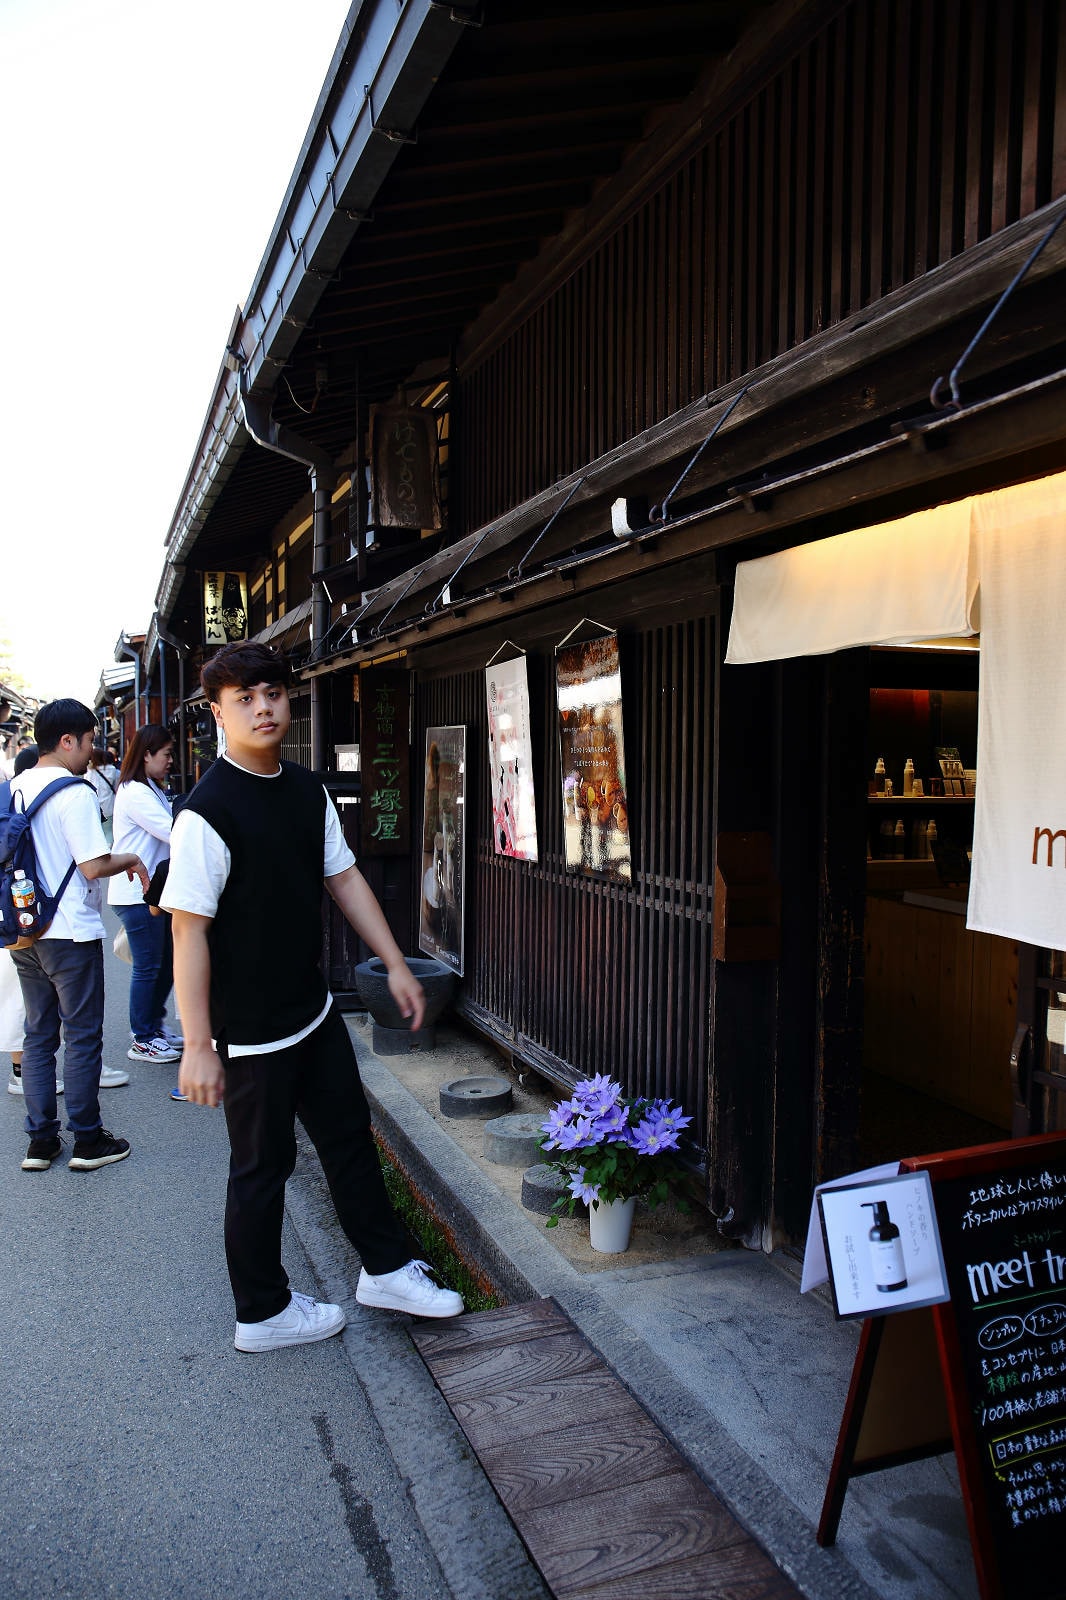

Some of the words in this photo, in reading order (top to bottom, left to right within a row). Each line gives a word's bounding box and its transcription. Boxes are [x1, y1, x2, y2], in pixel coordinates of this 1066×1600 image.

[370, 743, 404, 841] 三ツ塚屋
[961, 1194, 1066, 1231] ボタニカルなライフスタイル
[966, 1250, 1036, 1303] meet
[984, 1323, 1017, 1343] シンプル
